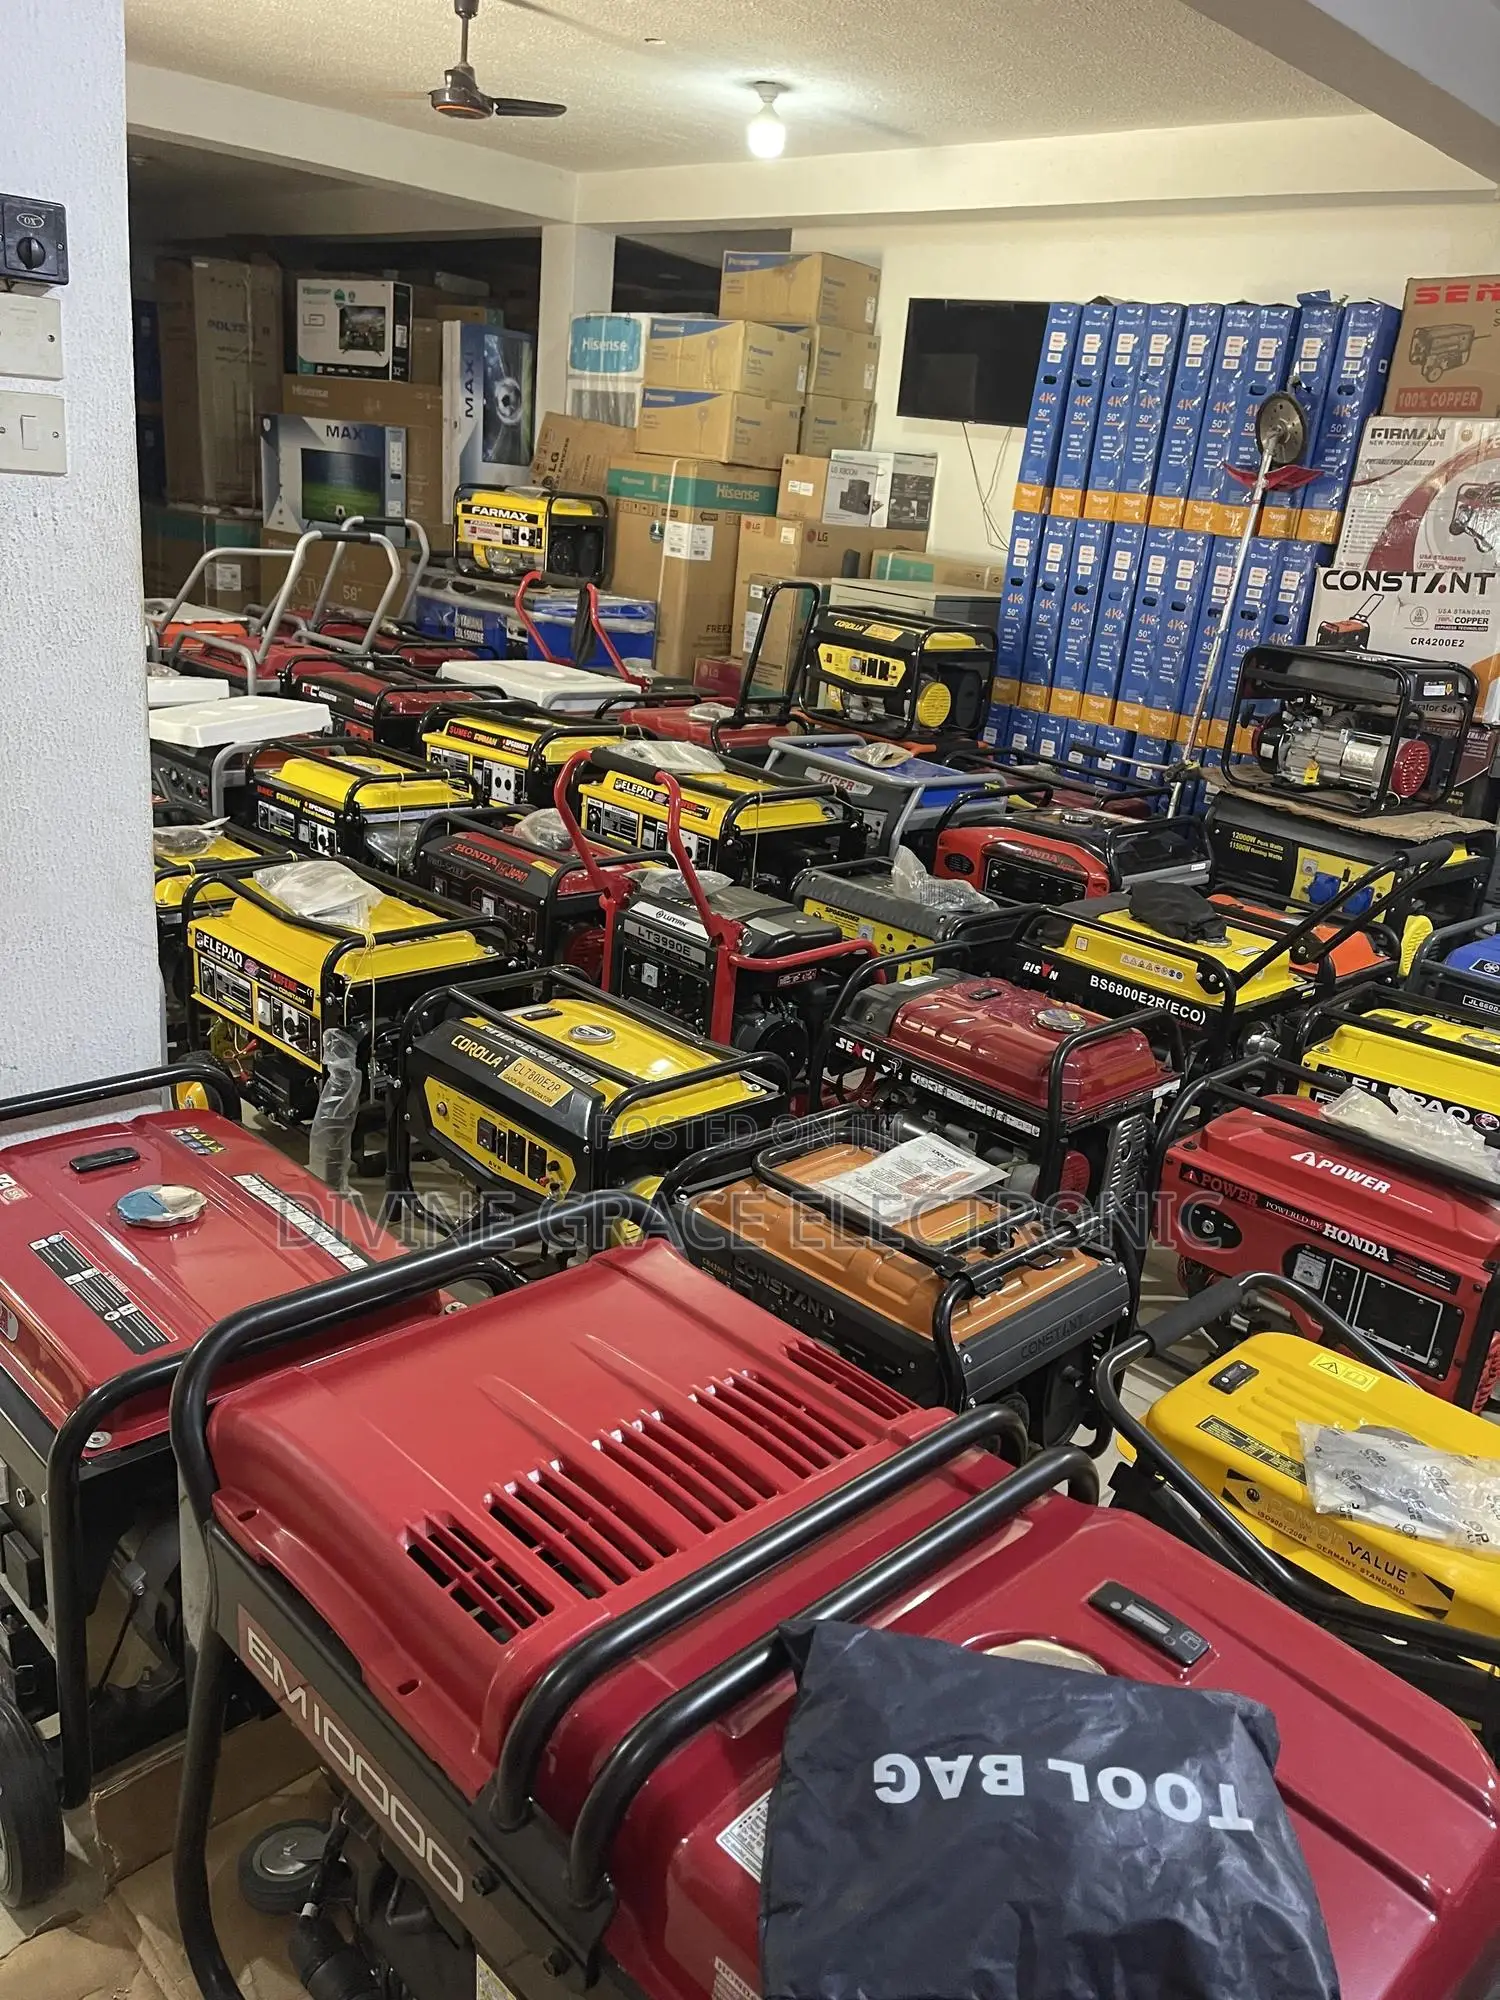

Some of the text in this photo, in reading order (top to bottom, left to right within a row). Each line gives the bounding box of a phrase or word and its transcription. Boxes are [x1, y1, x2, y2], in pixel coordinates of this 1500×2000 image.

[582, 336, 630, 354] Hisense
[1370, 428, 1446, 441] FIRMAN
[716, 484, 760, 502] Hisense
[471, 506, 528, 522] FARMAX
[752, 522, 761, 530] LG
[817, 530, 829, 542] LG
[1322, 570, 1496, 595] CONSTANT
[1453, 608, 1491, 616] STANDARD
[1454, 616, 1489, 625] COPPER
[1410, 637, 1465, 648] CR4200E2
[620, 780, 655, 800] ELEPAQ
[819, 772, 856, 792] TIGER
[455, 842, 499, 867] HONDA
[203, 934, 243, 969] ELEPAQ
[637, 926, 692, 957] LT3990E
[1089, 974, 1207, 1026] BS6800E2R(ECO)
[450, 1033, 504, 1069] COROLLA
[1322, 1222, 1391, 1263] HONDA
[1316, 1542, 1358, 1569] GERMANY
[1359, 1567, 1406, 1597] STANDARD
[1347, 1540, 1409, 1584] VALUE
[873, 1753, 1255, 1833] TOOL BAG
